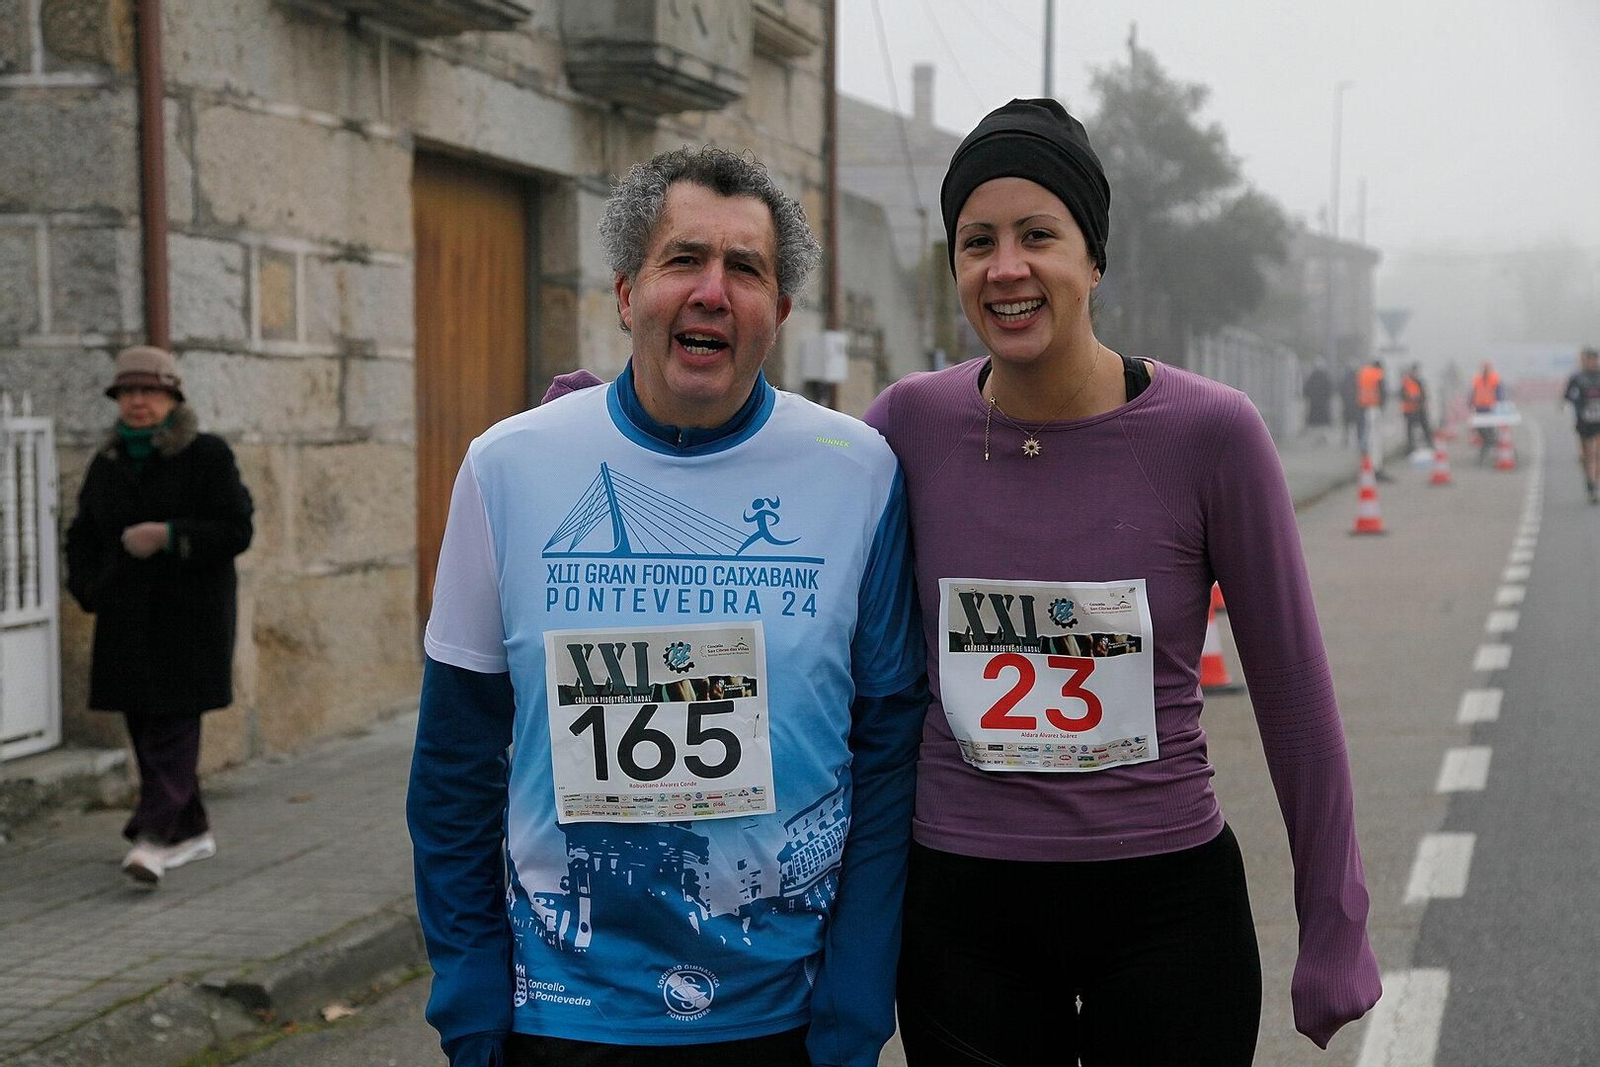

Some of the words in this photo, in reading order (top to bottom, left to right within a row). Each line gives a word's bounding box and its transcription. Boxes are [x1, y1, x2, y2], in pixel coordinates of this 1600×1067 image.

[546, 563, 581, 585] XLII
[585, 563, 636, 585] GRAN
[642, 564, 707, 587] FONDO
[713, 565, 819, 590] CAIXABANK
[546, 587, 762, 615] PONTEVEDRA
[781, 590, 817, 618] 24
[958, 592, 1040, 645] XXI
[963, 644, 989, 652] CARREIRA
[1023, 645, 1041, 653] NADAL
[566, 641, 650, 695] XXI
[633, 694, 652, 703] NADAL
[980, 652, 1103, 733] 23
[568, 699, 743, 782] 165
[527, 979, 565, 993] Concello
[657, 964, 683, 989] SOCIEDAD
[534, 991, 592, 1006] Pontevedra
[666, 1008, 712, 1022] PONTEVEDRA
